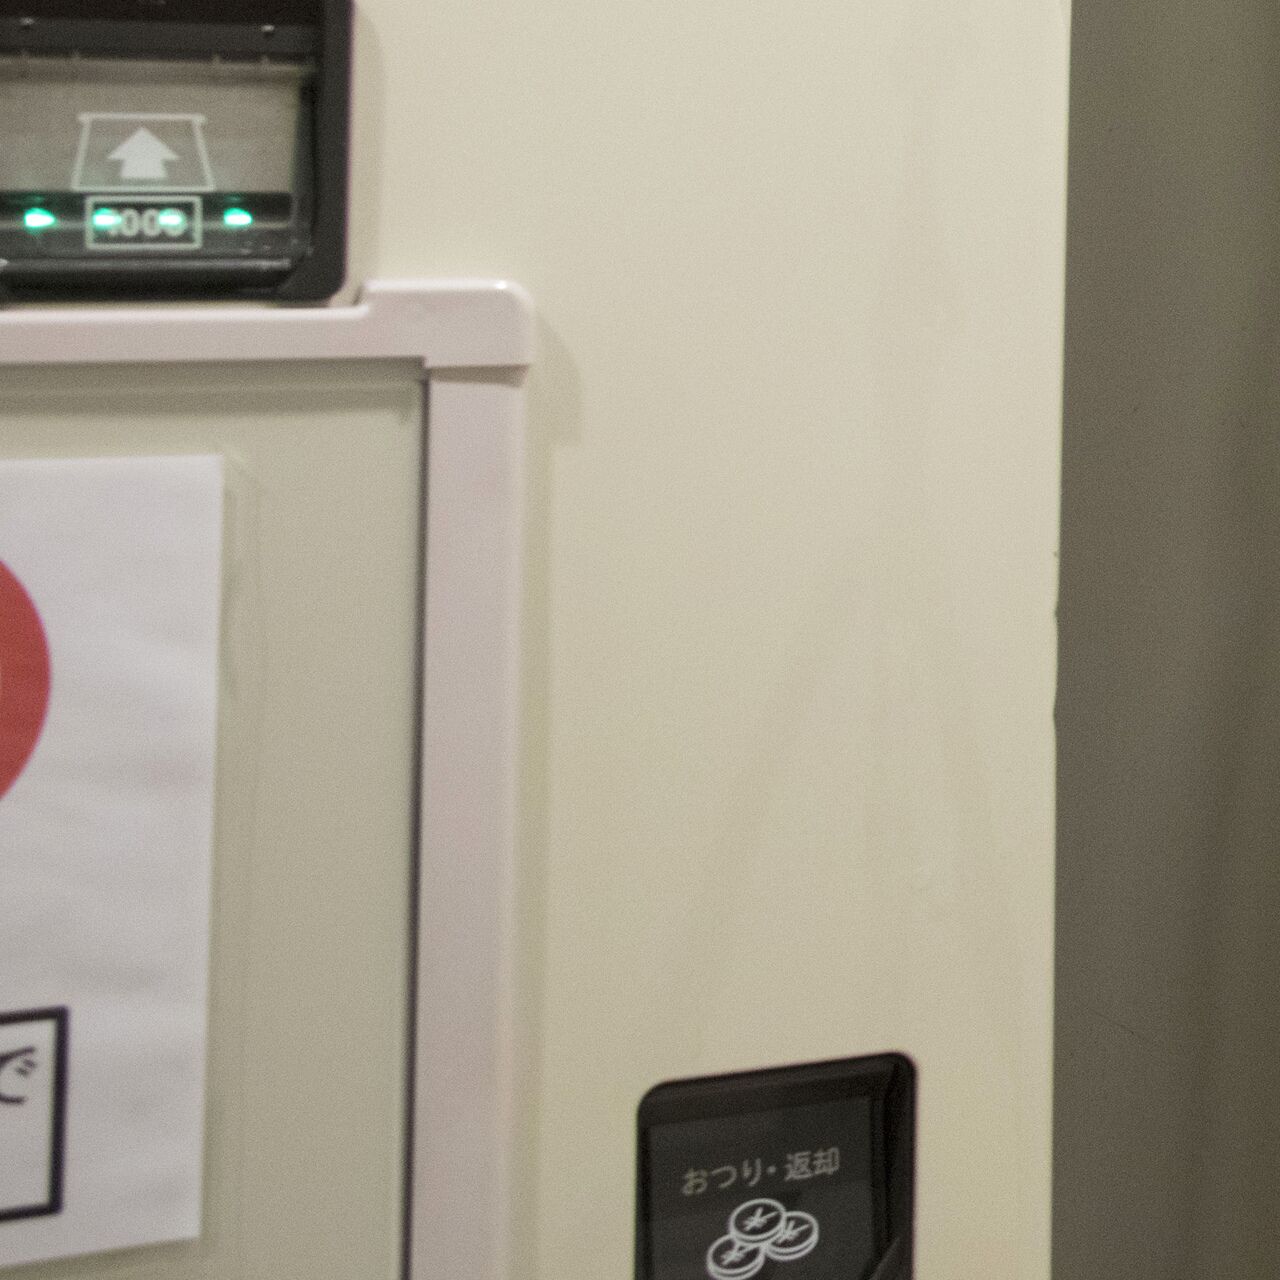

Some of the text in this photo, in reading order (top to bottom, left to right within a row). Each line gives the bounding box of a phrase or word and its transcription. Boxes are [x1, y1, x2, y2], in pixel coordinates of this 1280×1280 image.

[682, 1147, 841, 1197] おつり・返却
